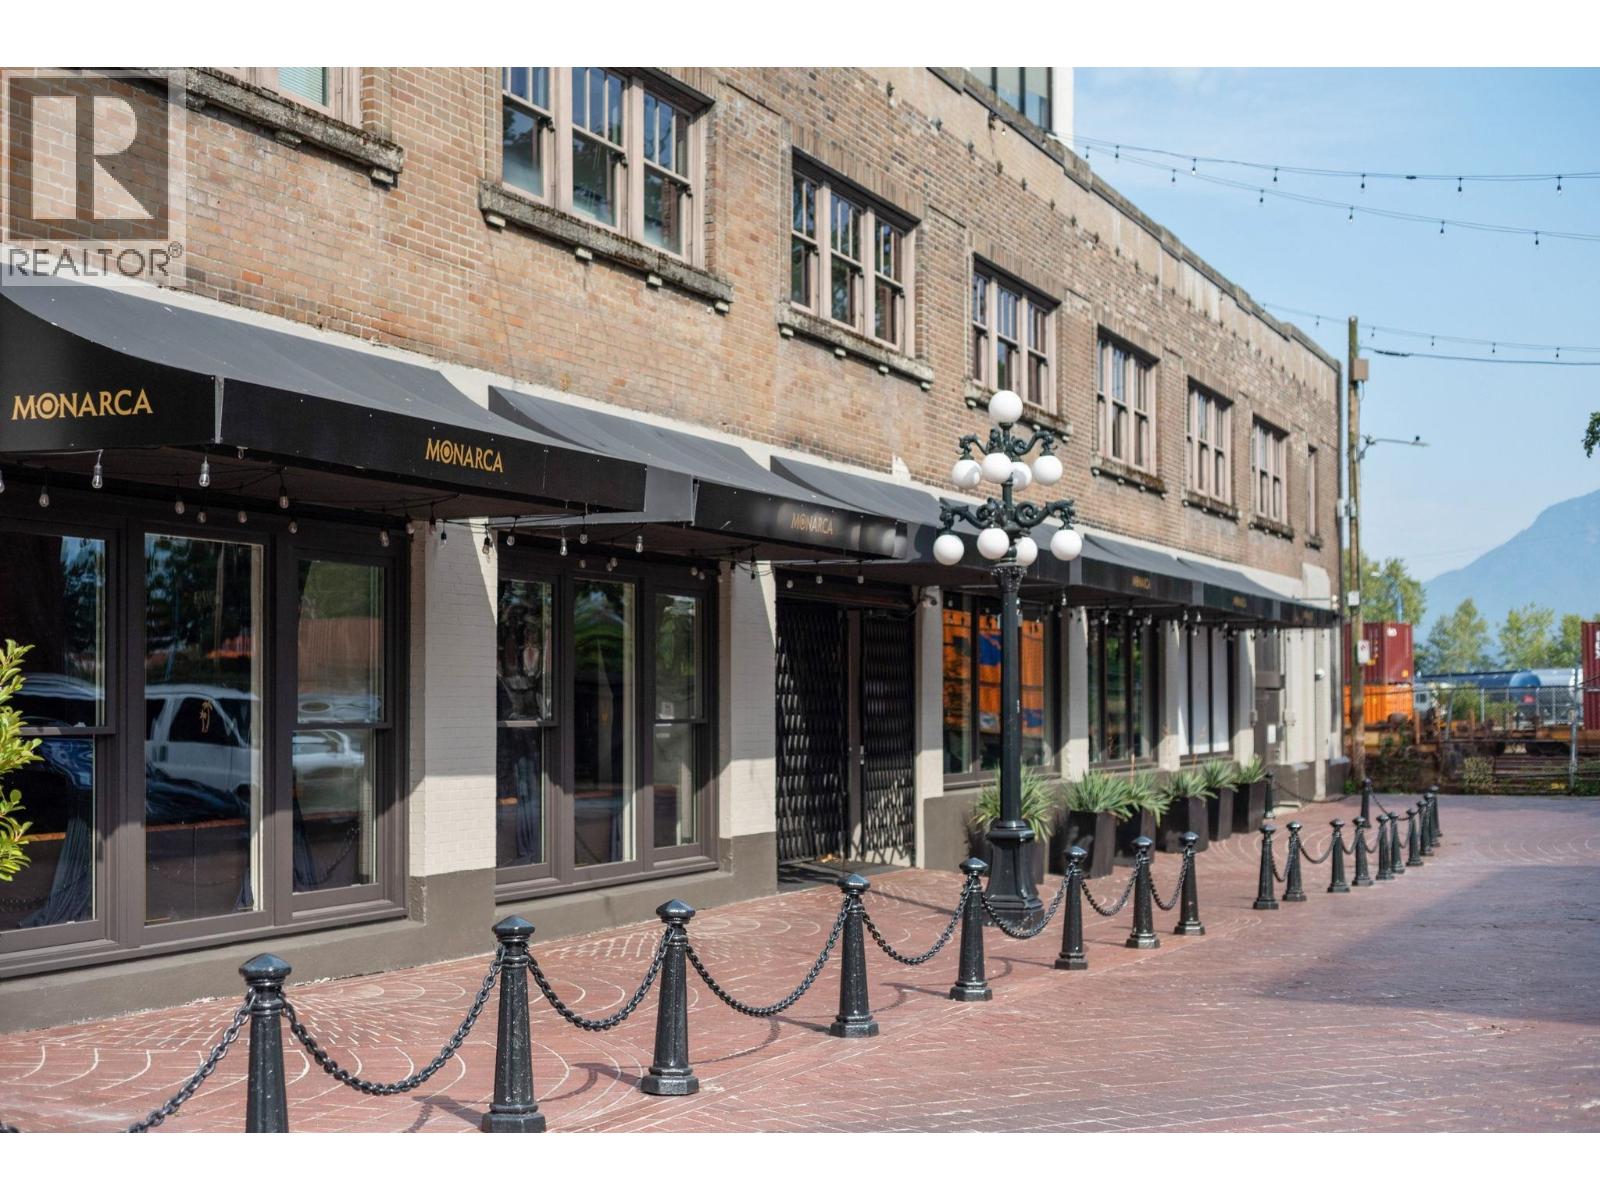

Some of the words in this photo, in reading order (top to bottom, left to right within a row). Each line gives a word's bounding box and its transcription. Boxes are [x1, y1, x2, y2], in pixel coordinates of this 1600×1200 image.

[11, 388, 153, 421] MONARCA
[425, 437, 504, 473] MONARCA
[790, 511, 833, 535] MONARCA
